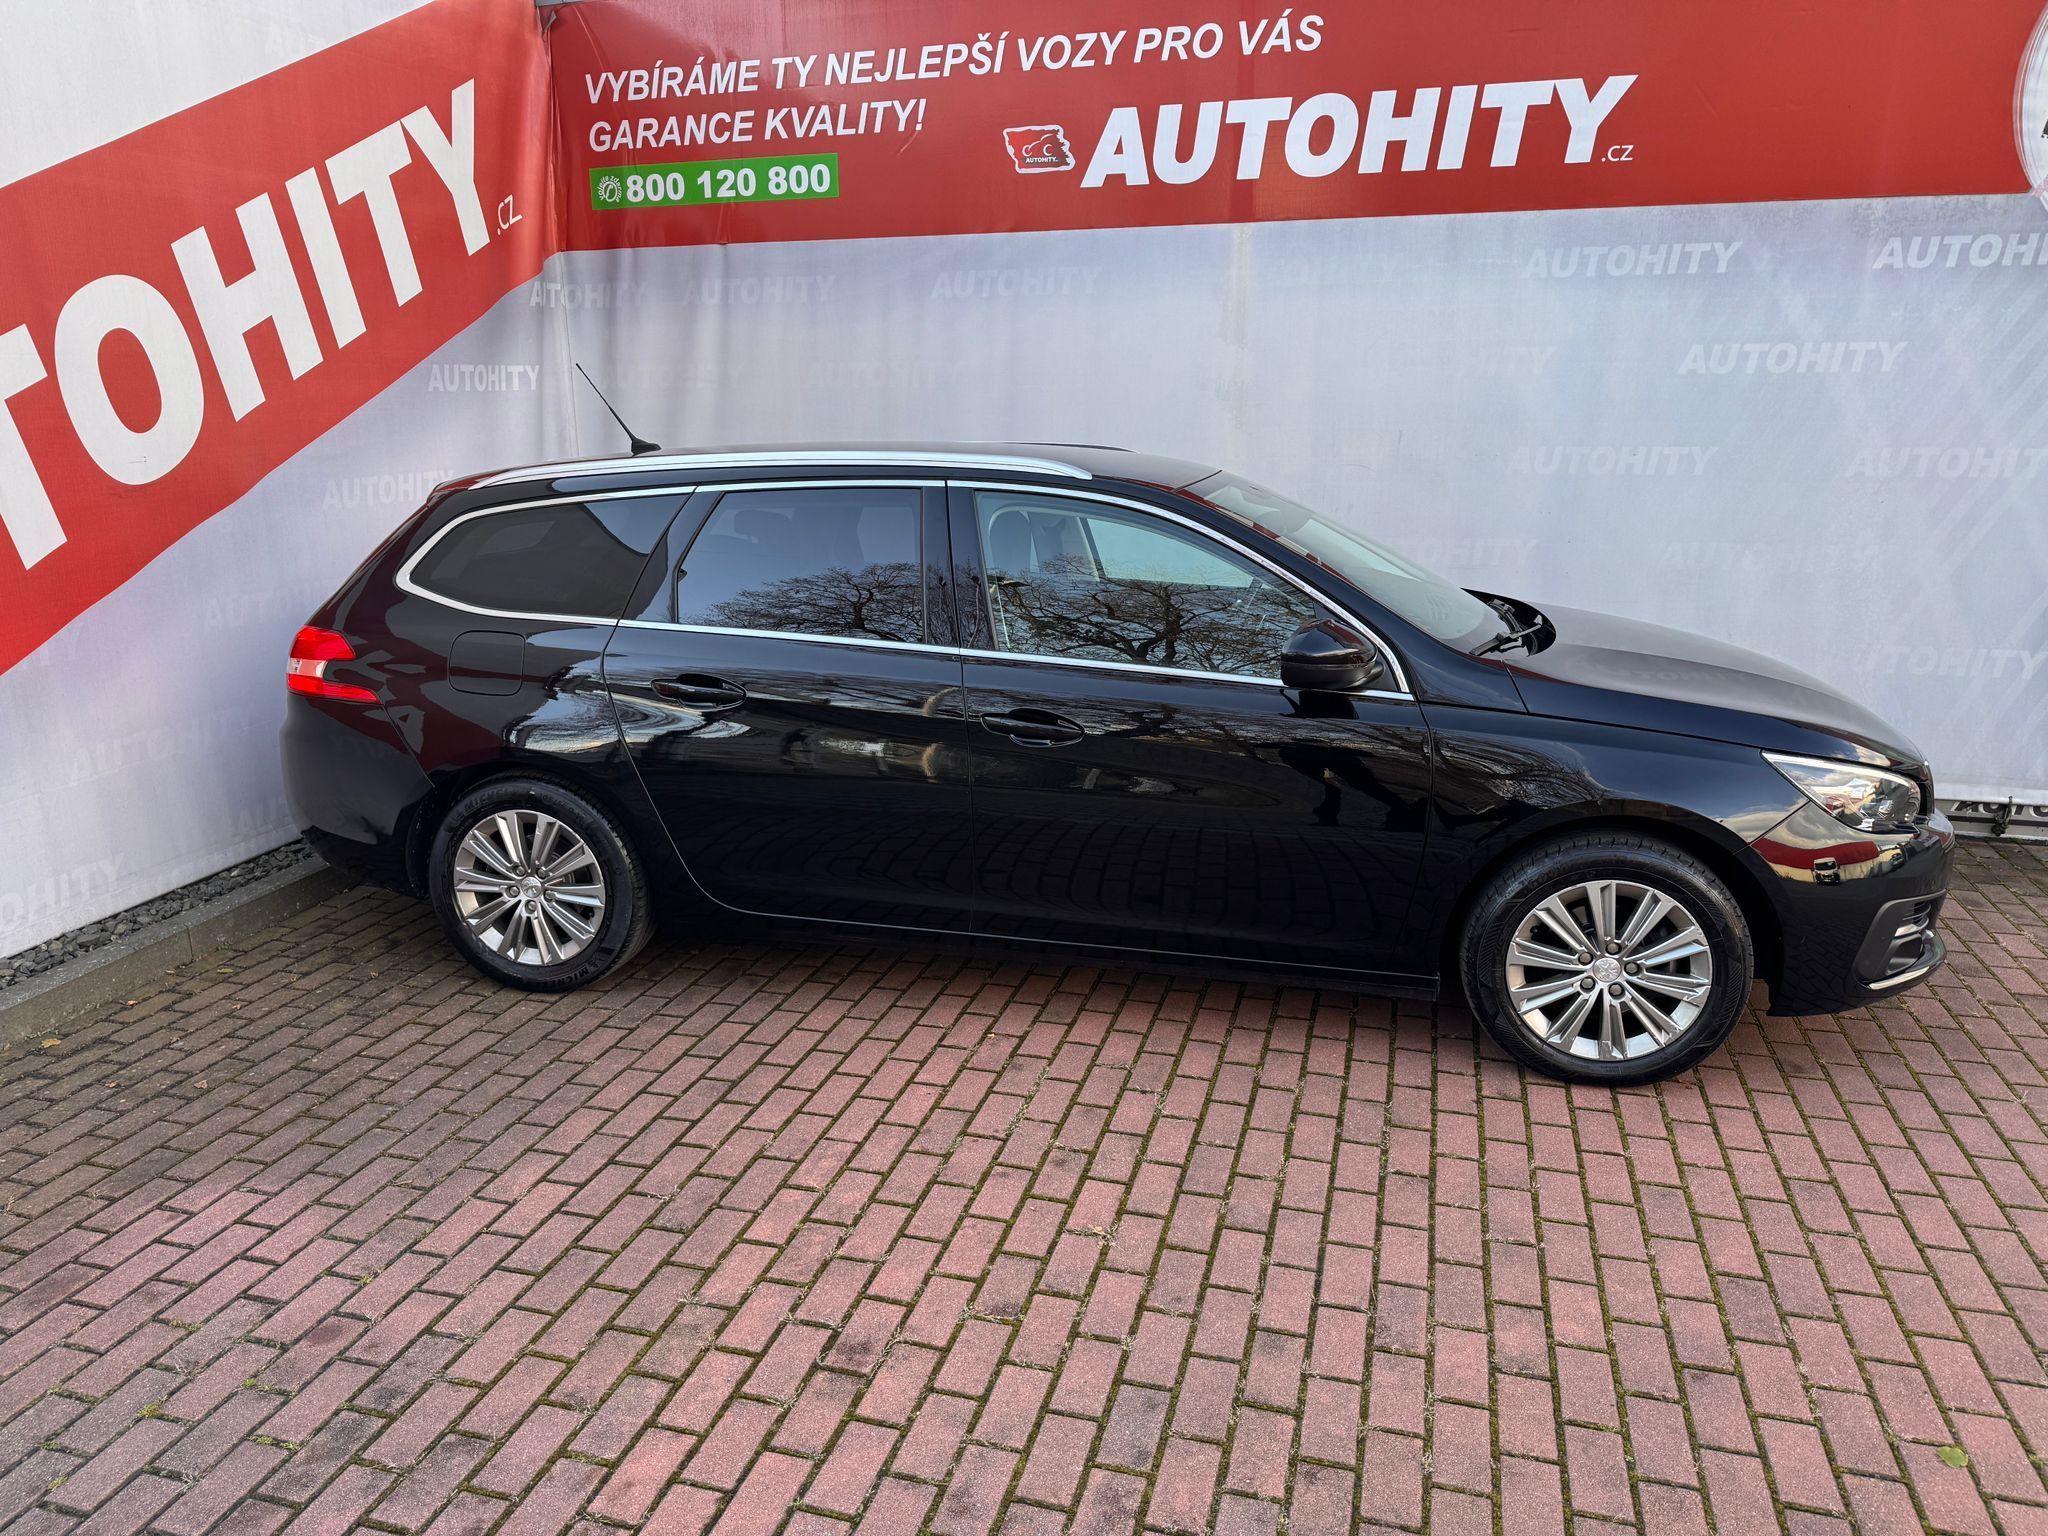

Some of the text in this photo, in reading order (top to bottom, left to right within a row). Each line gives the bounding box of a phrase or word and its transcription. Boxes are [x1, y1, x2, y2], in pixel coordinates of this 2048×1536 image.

[585, 8, 1325, 104] VYBÍRÁME TY NEJLEPŠÍ VOZY PRO VÁS
[589, 98, 927, 152] GARANCE KVALITY!
[626, 163, 831, 203] 800 120 800
[1520, 241, 1743, 279] AUTOHITY
[1677, 341, 1908, 375] AUTOHITY
[428, 363, 541, 392] AUTOHITY
[1504, 445, 1719, 476] AUTOHITY
